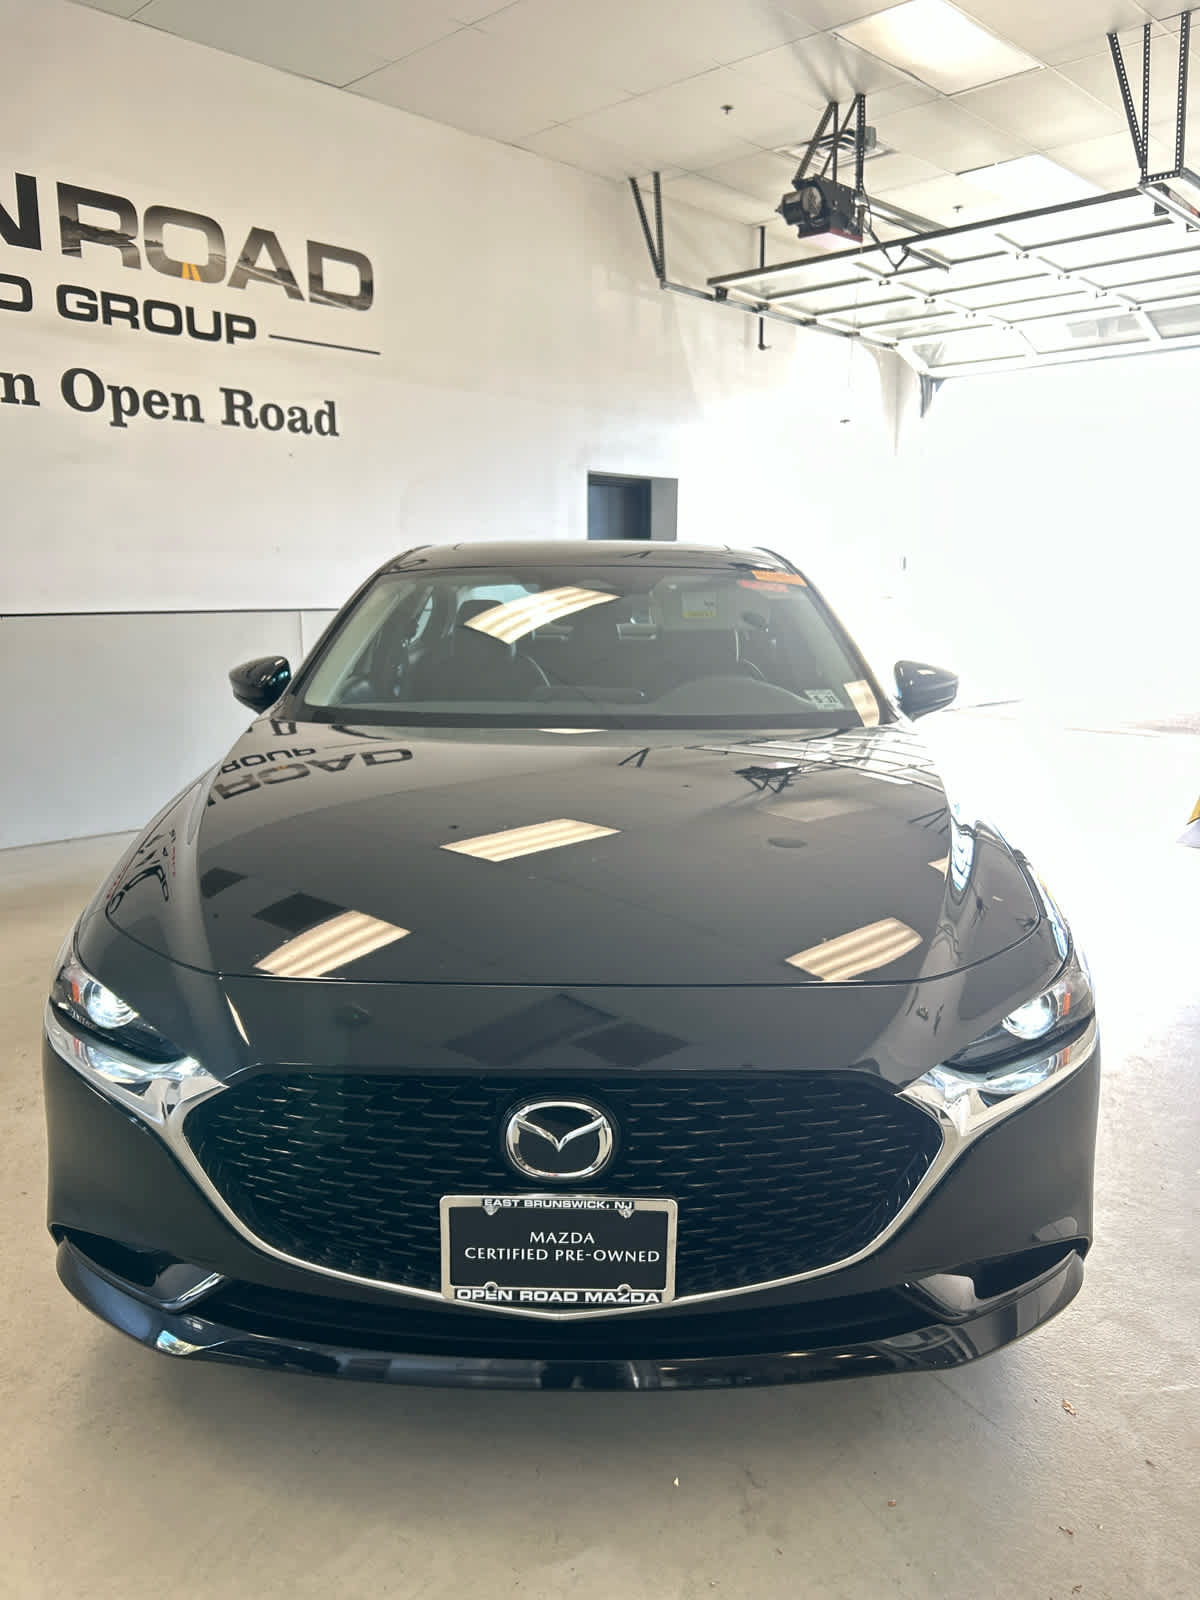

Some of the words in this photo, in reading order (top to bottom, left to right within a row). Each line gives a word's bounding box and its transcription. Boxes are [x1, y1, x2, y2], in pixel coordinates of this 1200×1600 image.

[56, 283, 257, 345] GROUP
[60, 367, 205, 428] Open
[219, 387, 340, 437] Road
[484, 1198, 520, 1207] EAST
[524, 1199, 610, 1209] BRUNSWICK,
[614, 1201, 633, 1210] NJ
[529, 1231, 595, 1244] MAZDA
[464, 1247, 549, 1261] CERTIFIED
[555, 1249, 660, 1262] PRE-OWNED
[456, 1289, 513, 1301] OPEN
[519, 1290, 578, 1302] ROAD
[584, 1291, 660, 1303] MAZDA
